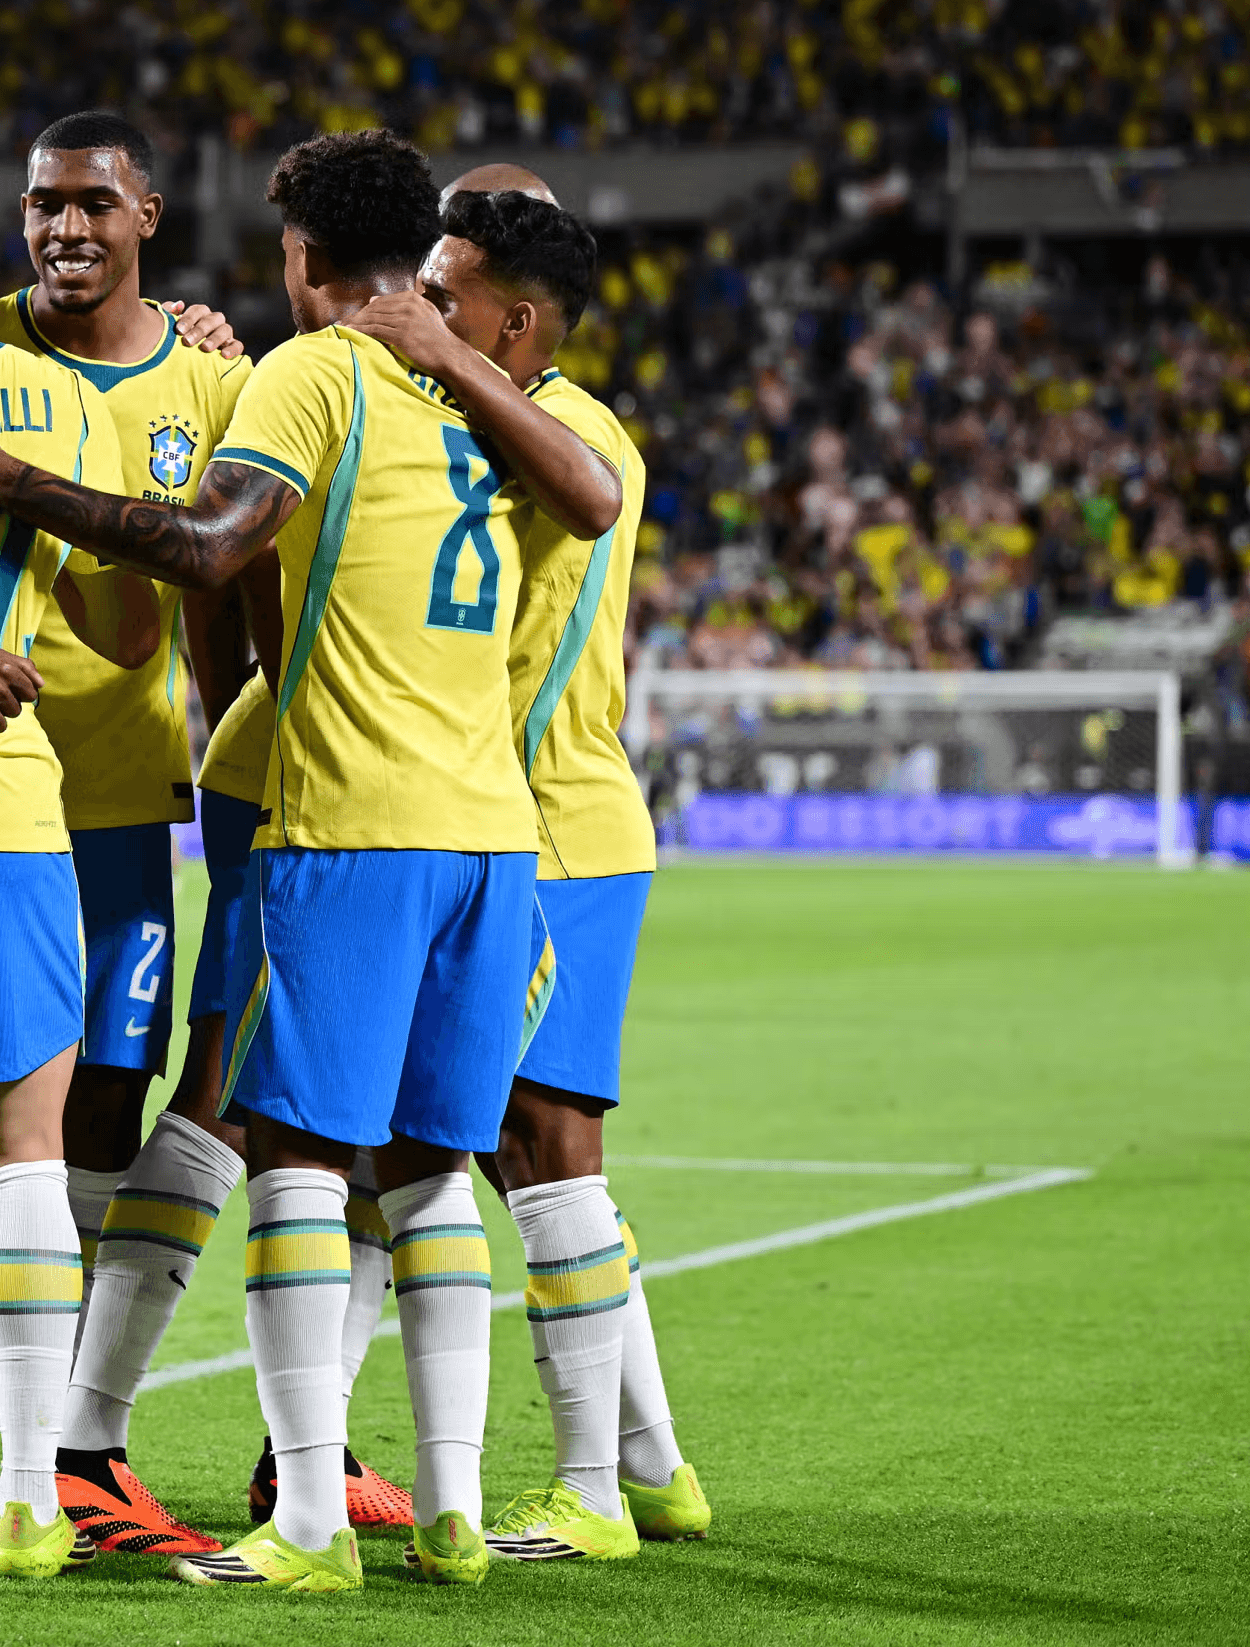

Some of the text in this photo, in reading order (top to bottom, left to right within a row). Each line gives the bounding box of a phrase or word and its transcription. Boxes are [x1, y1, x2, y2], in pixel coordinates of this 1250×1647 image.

[163, 451, 180, 461] CBF
[424, 422, 501, 636] 8
[128, 921, 167, 1003] 2
